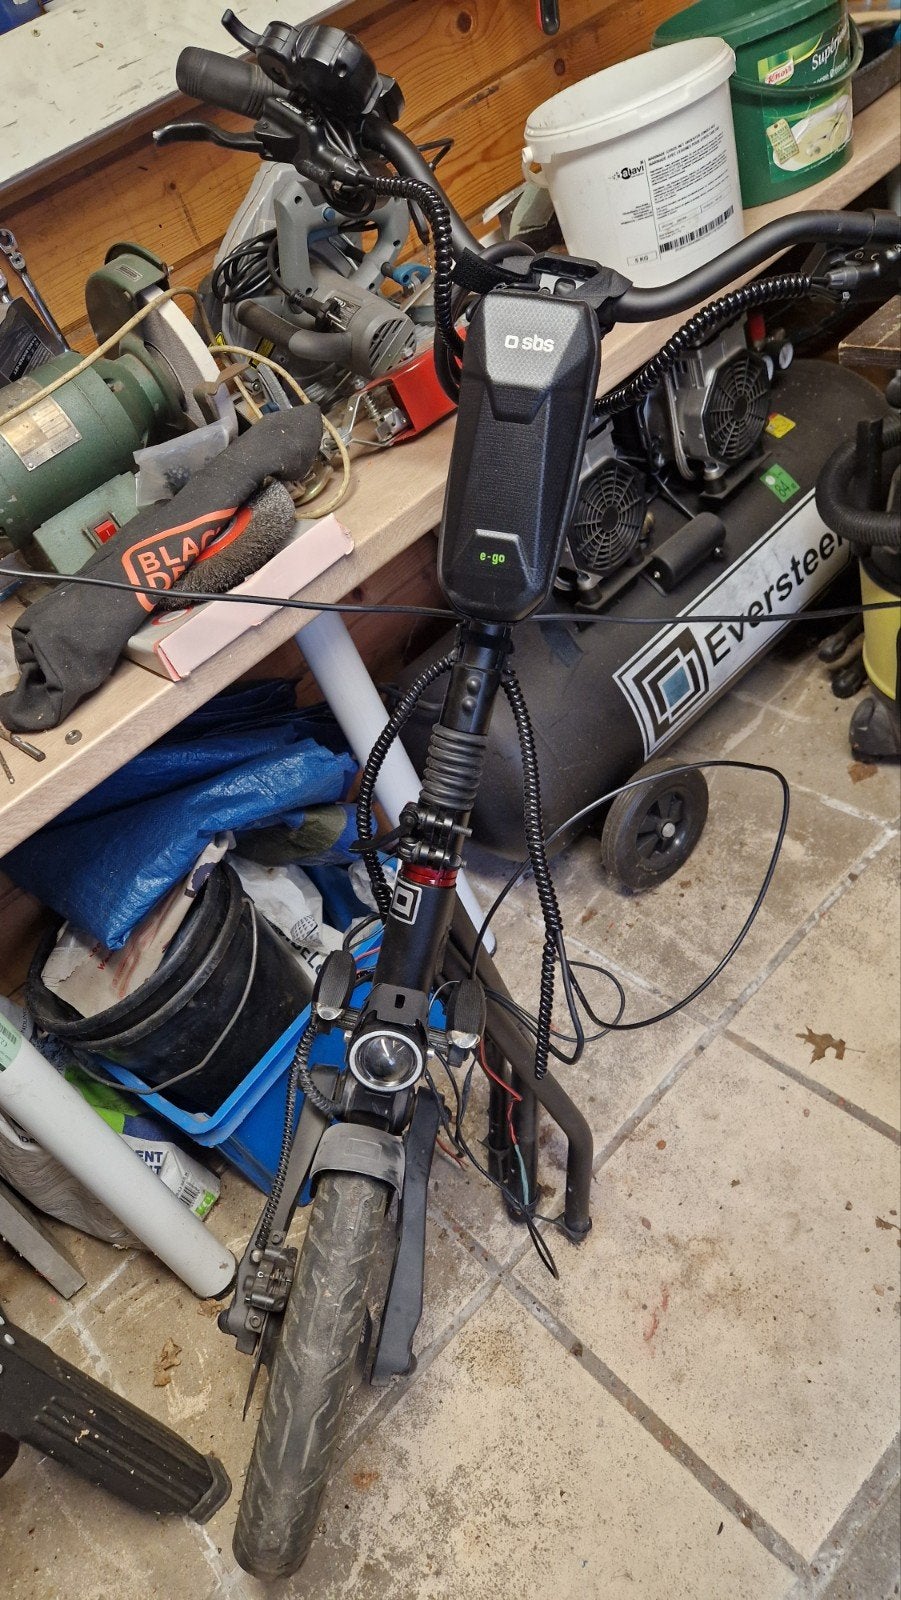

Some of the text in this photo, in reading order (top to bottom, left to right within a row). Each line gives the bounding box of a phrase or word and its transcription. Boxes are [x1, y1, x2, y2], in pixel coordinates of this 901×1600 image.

[521, 333, 555, 352] sbs
[137, 526, 221, 573] BLAC
[479, 551, 506, 565] e-go
